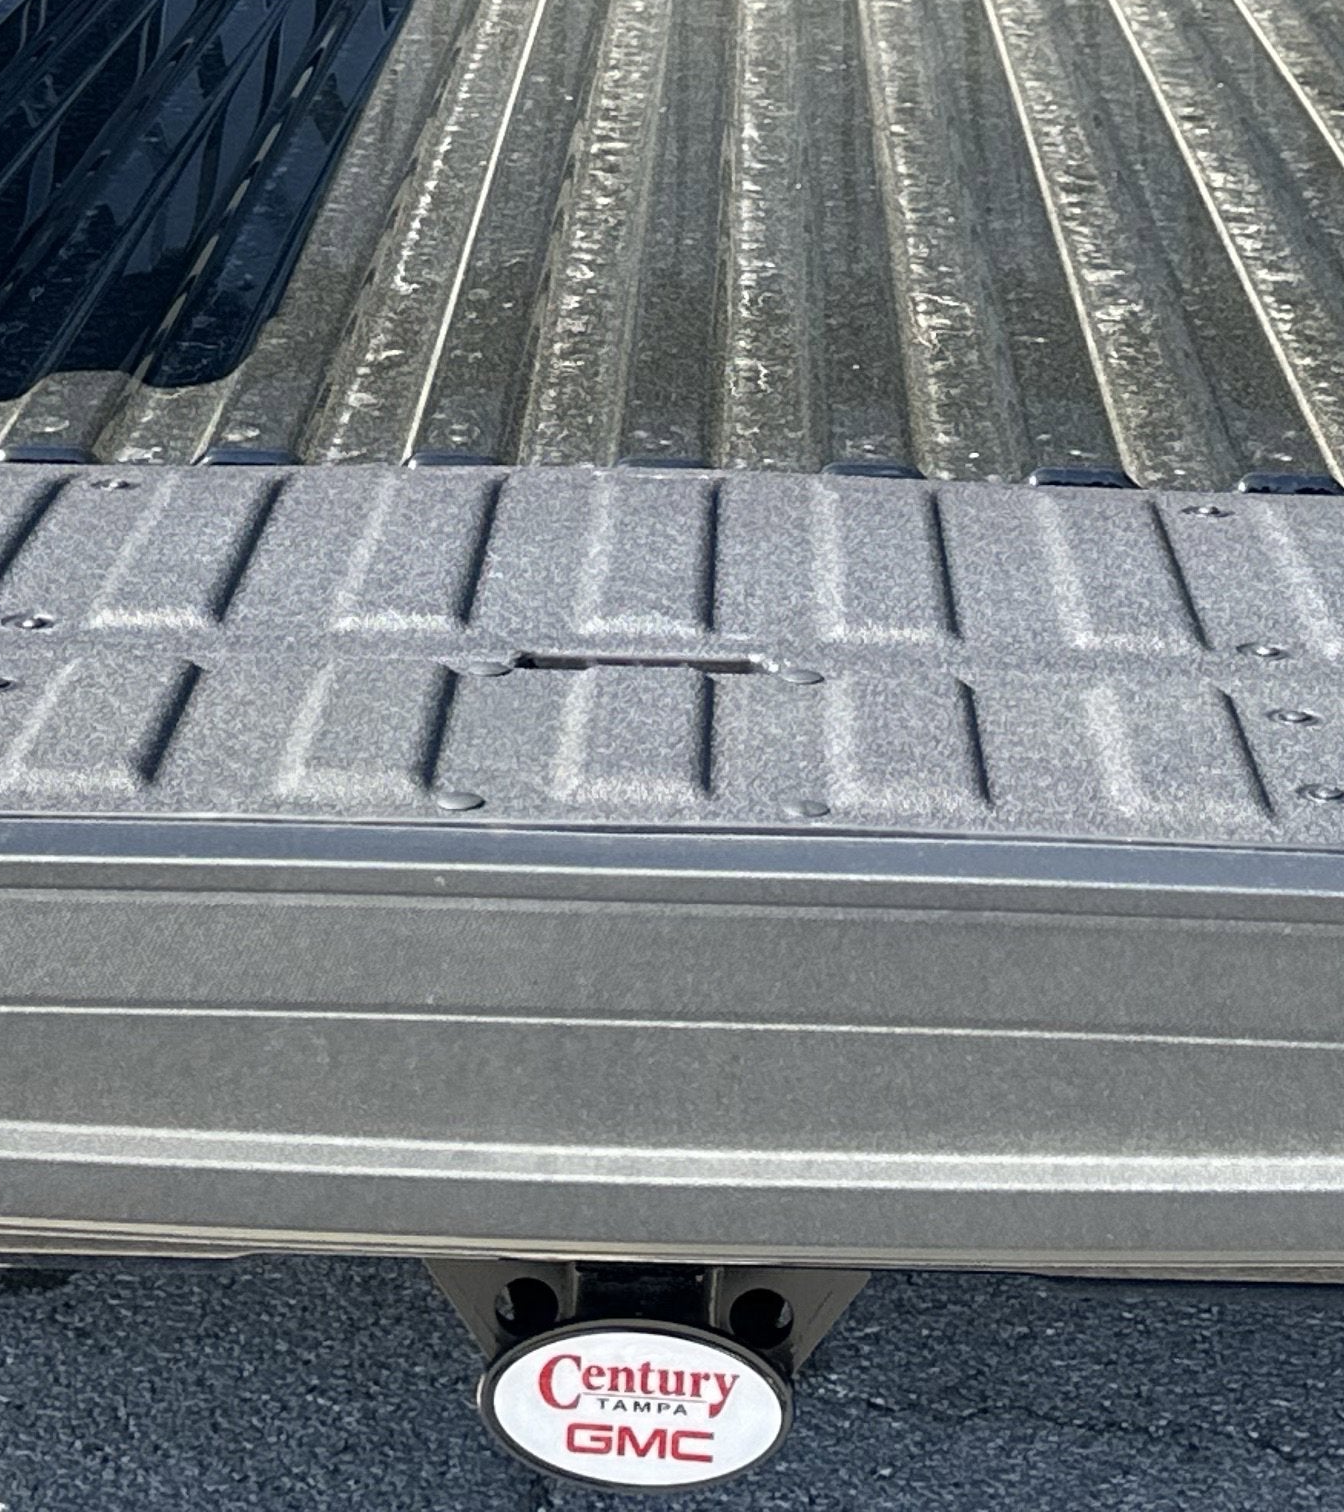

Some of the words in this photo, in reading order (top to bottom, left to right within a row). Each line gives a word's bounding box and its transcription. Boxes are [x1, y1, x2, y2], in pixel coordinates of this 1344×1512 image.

[538, 1354, 740, 1419] Century
[596, 1398, 688, 1416] TAMPA
[566, 1422, 714, 1463] GMC
